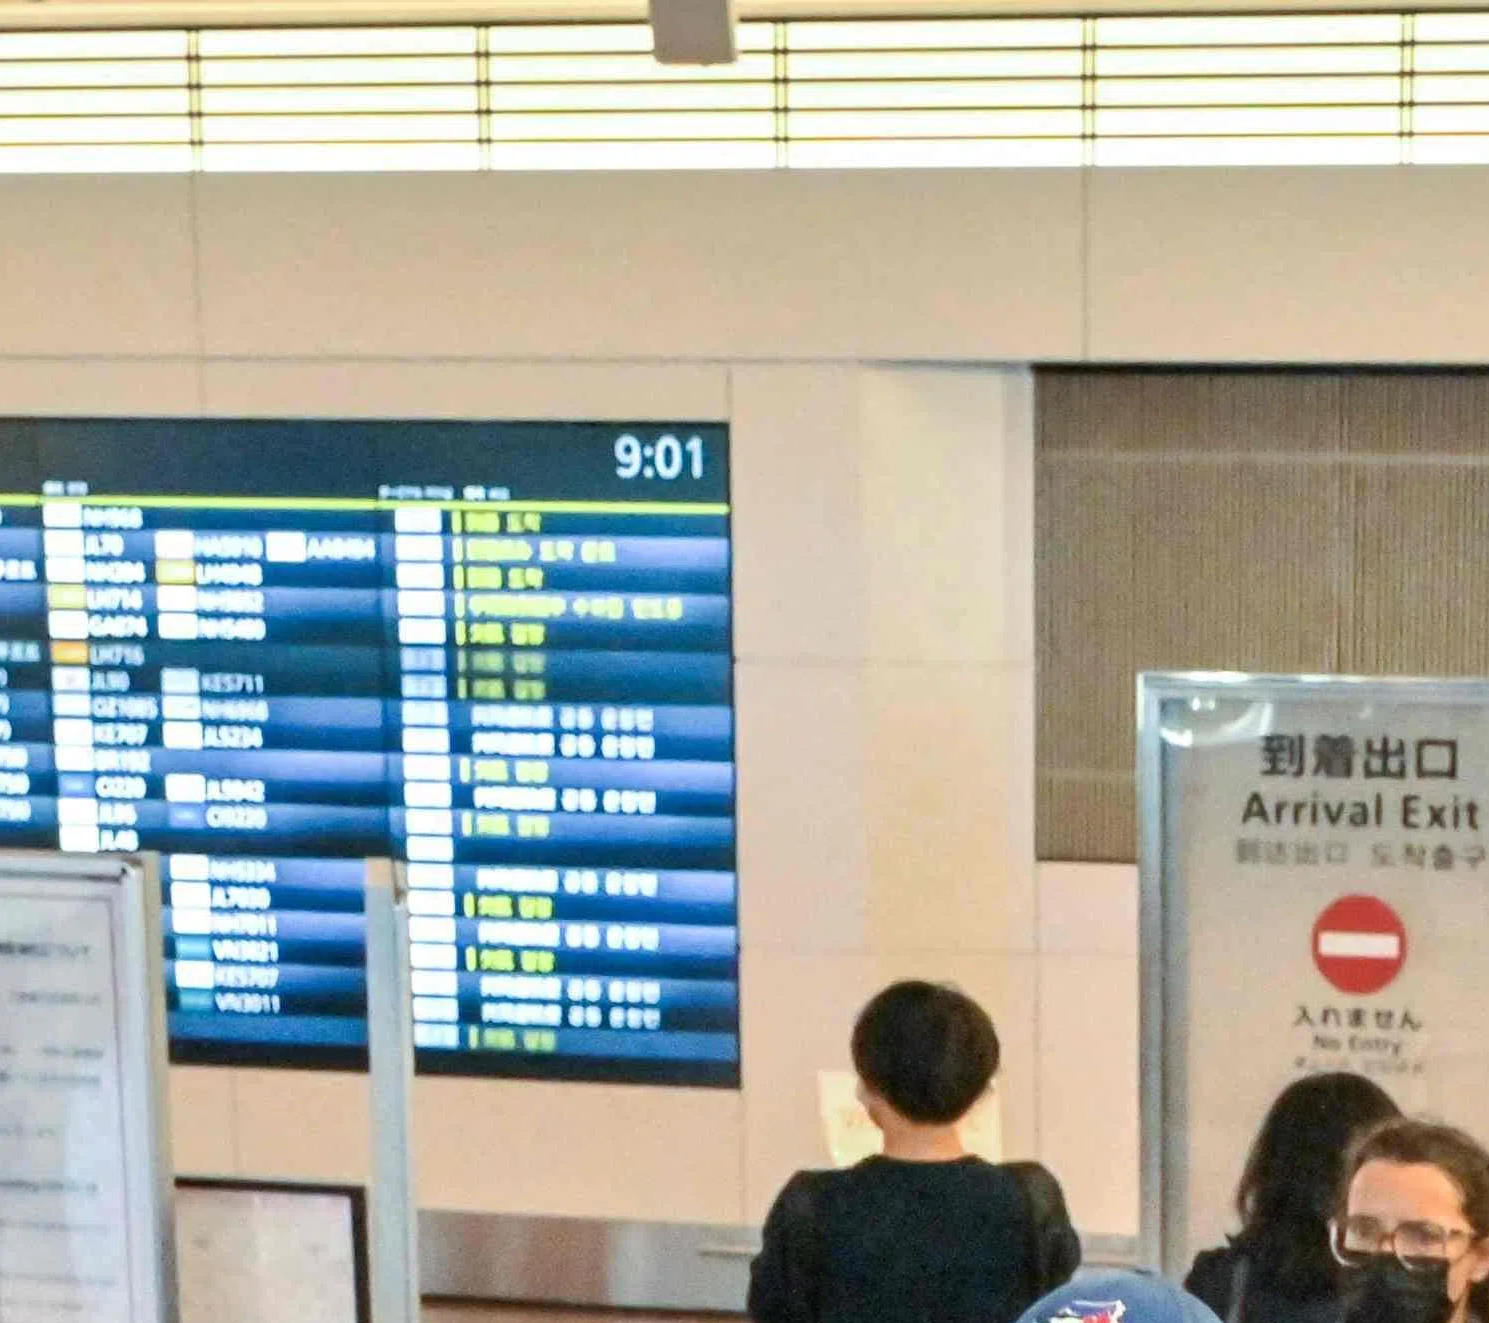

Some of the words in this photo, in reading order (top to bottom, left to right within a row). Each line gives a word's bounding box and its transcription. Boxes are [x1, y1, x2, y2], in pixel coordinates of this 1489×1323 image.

[613, 434, 705, 480] 9:01
[1260, 735, 1459, 779] 到着出口
[1241, 792, 1383, 828] Arrival
[1401, 794, 1480, 831] Exit
[1294, 1007, 1423, 1029] 入れません
[1312, 1034, 1341, 1051] No
[1348, 1035, 1403, 1055] Entry
